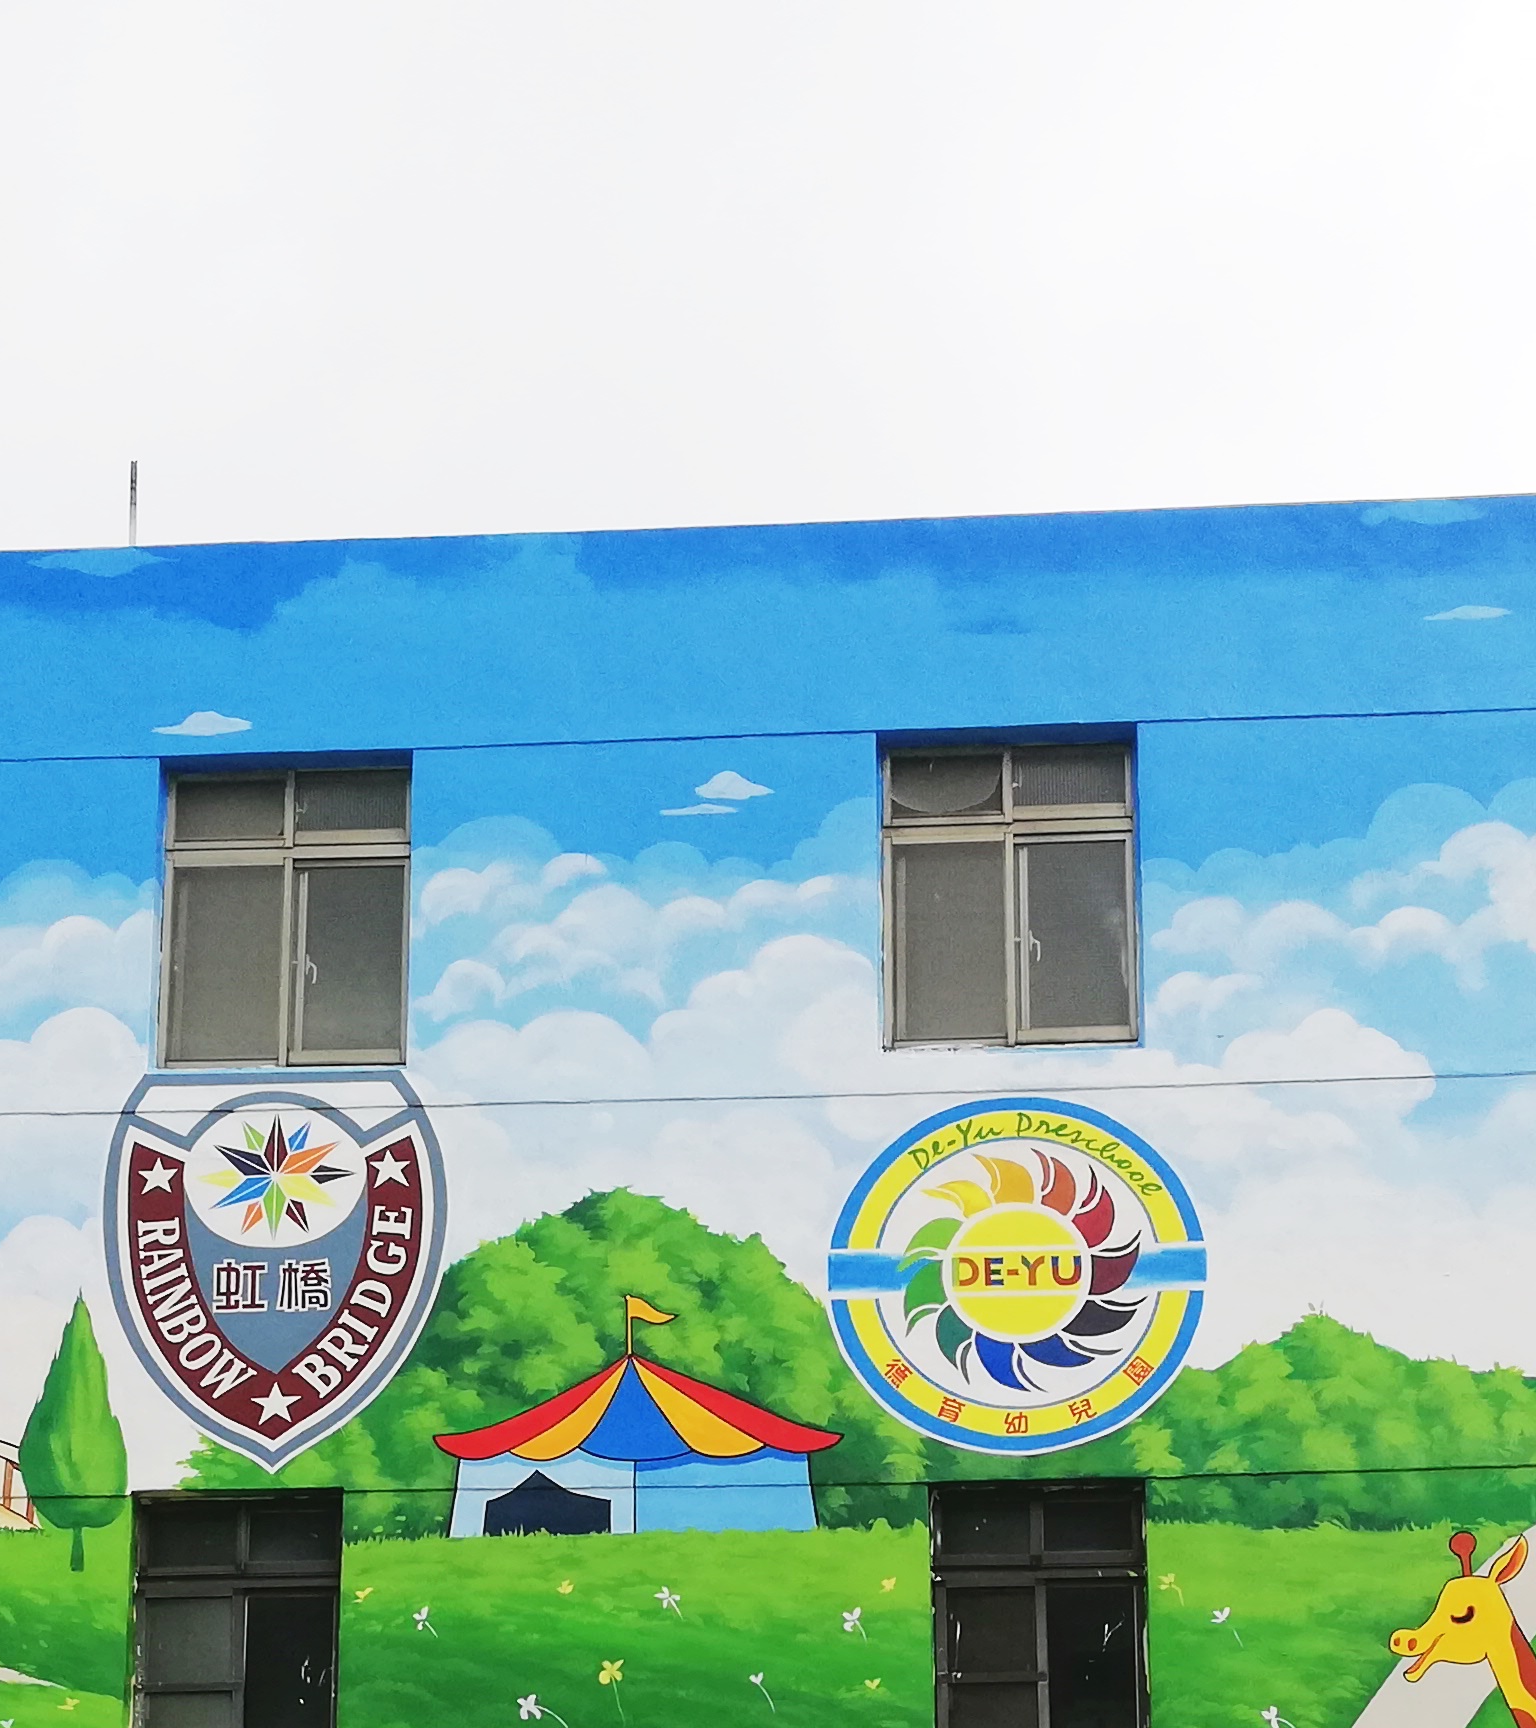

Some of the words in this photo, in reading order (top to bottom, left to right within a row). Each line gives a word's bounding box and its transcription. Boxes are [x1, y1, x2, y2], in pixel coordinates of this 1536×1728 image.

[908, 1119, 1004, 1170] De-Yu
[213, 1257, 332, 1313] 虹橋
[952, 1255, 1082, 1286] DE-YU
[137, 1217, 257, 1399] RAINBOW
[293, 1205, 413, 1399] BRIDGE
